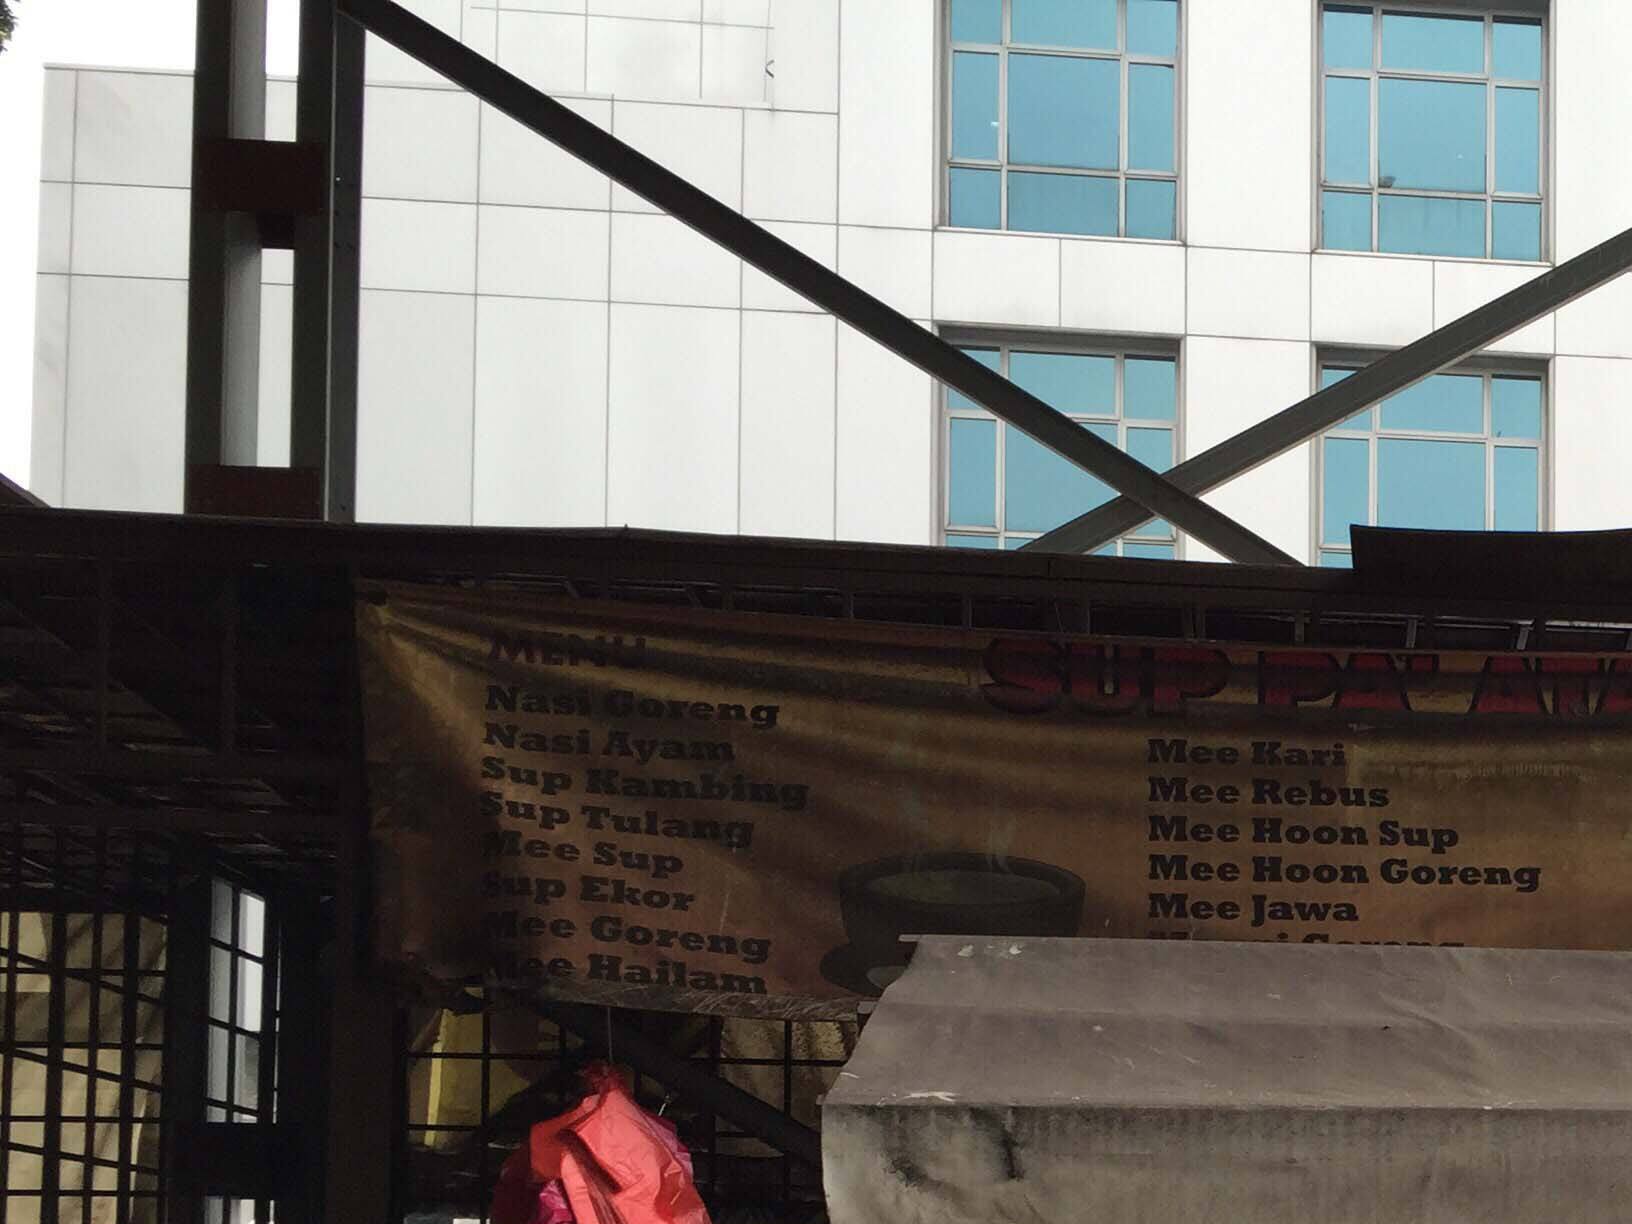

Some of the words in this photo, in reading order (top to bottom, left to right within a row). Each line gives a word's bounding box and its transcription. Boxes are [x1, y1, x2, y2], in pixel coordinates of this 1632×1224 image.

[982, 637, 1234, 717] SUP
[485, 685, 591, 716] Nasi
[605, 689, 780, 730] Goreng
[483, 722, 591, 754] Nasi
[602, 730, 736, 764] Ayam
[1146, 738, 1240, 766] Mee
[1251, 741, 1346, 768] Kari
[481, 756, 572, 795] Sup
[584, 767, 810, 811] Kambing
[1147, 777, 1241, 804] Mee
[1251, 778, 1390, 807] Rebus
[480, 791, 570, 829] Sup
[582, 804, 754, 849] Tulang
[1147, 815, 1241, 842] Mee
[1251, 817, 1369, 845] Hoon
[1379, 820, 1459, 854] Sup
[481, 830, 580, 861] Mee
[593, 841, 684, 878] Sup
[1147, 854, 1241, 882] Mee
[1251, 856, 1369, 883] Hoon
[1380, 858, 1541, 892] Goreng
[580, 875, 695, 911] Ekor
[1147, 893, 1241, 920] Mee
[1251, 895, 1360, 927] Jawa
[591, 915, 772, 964] Goreng
[588, 953, 768, 994] Hailam
